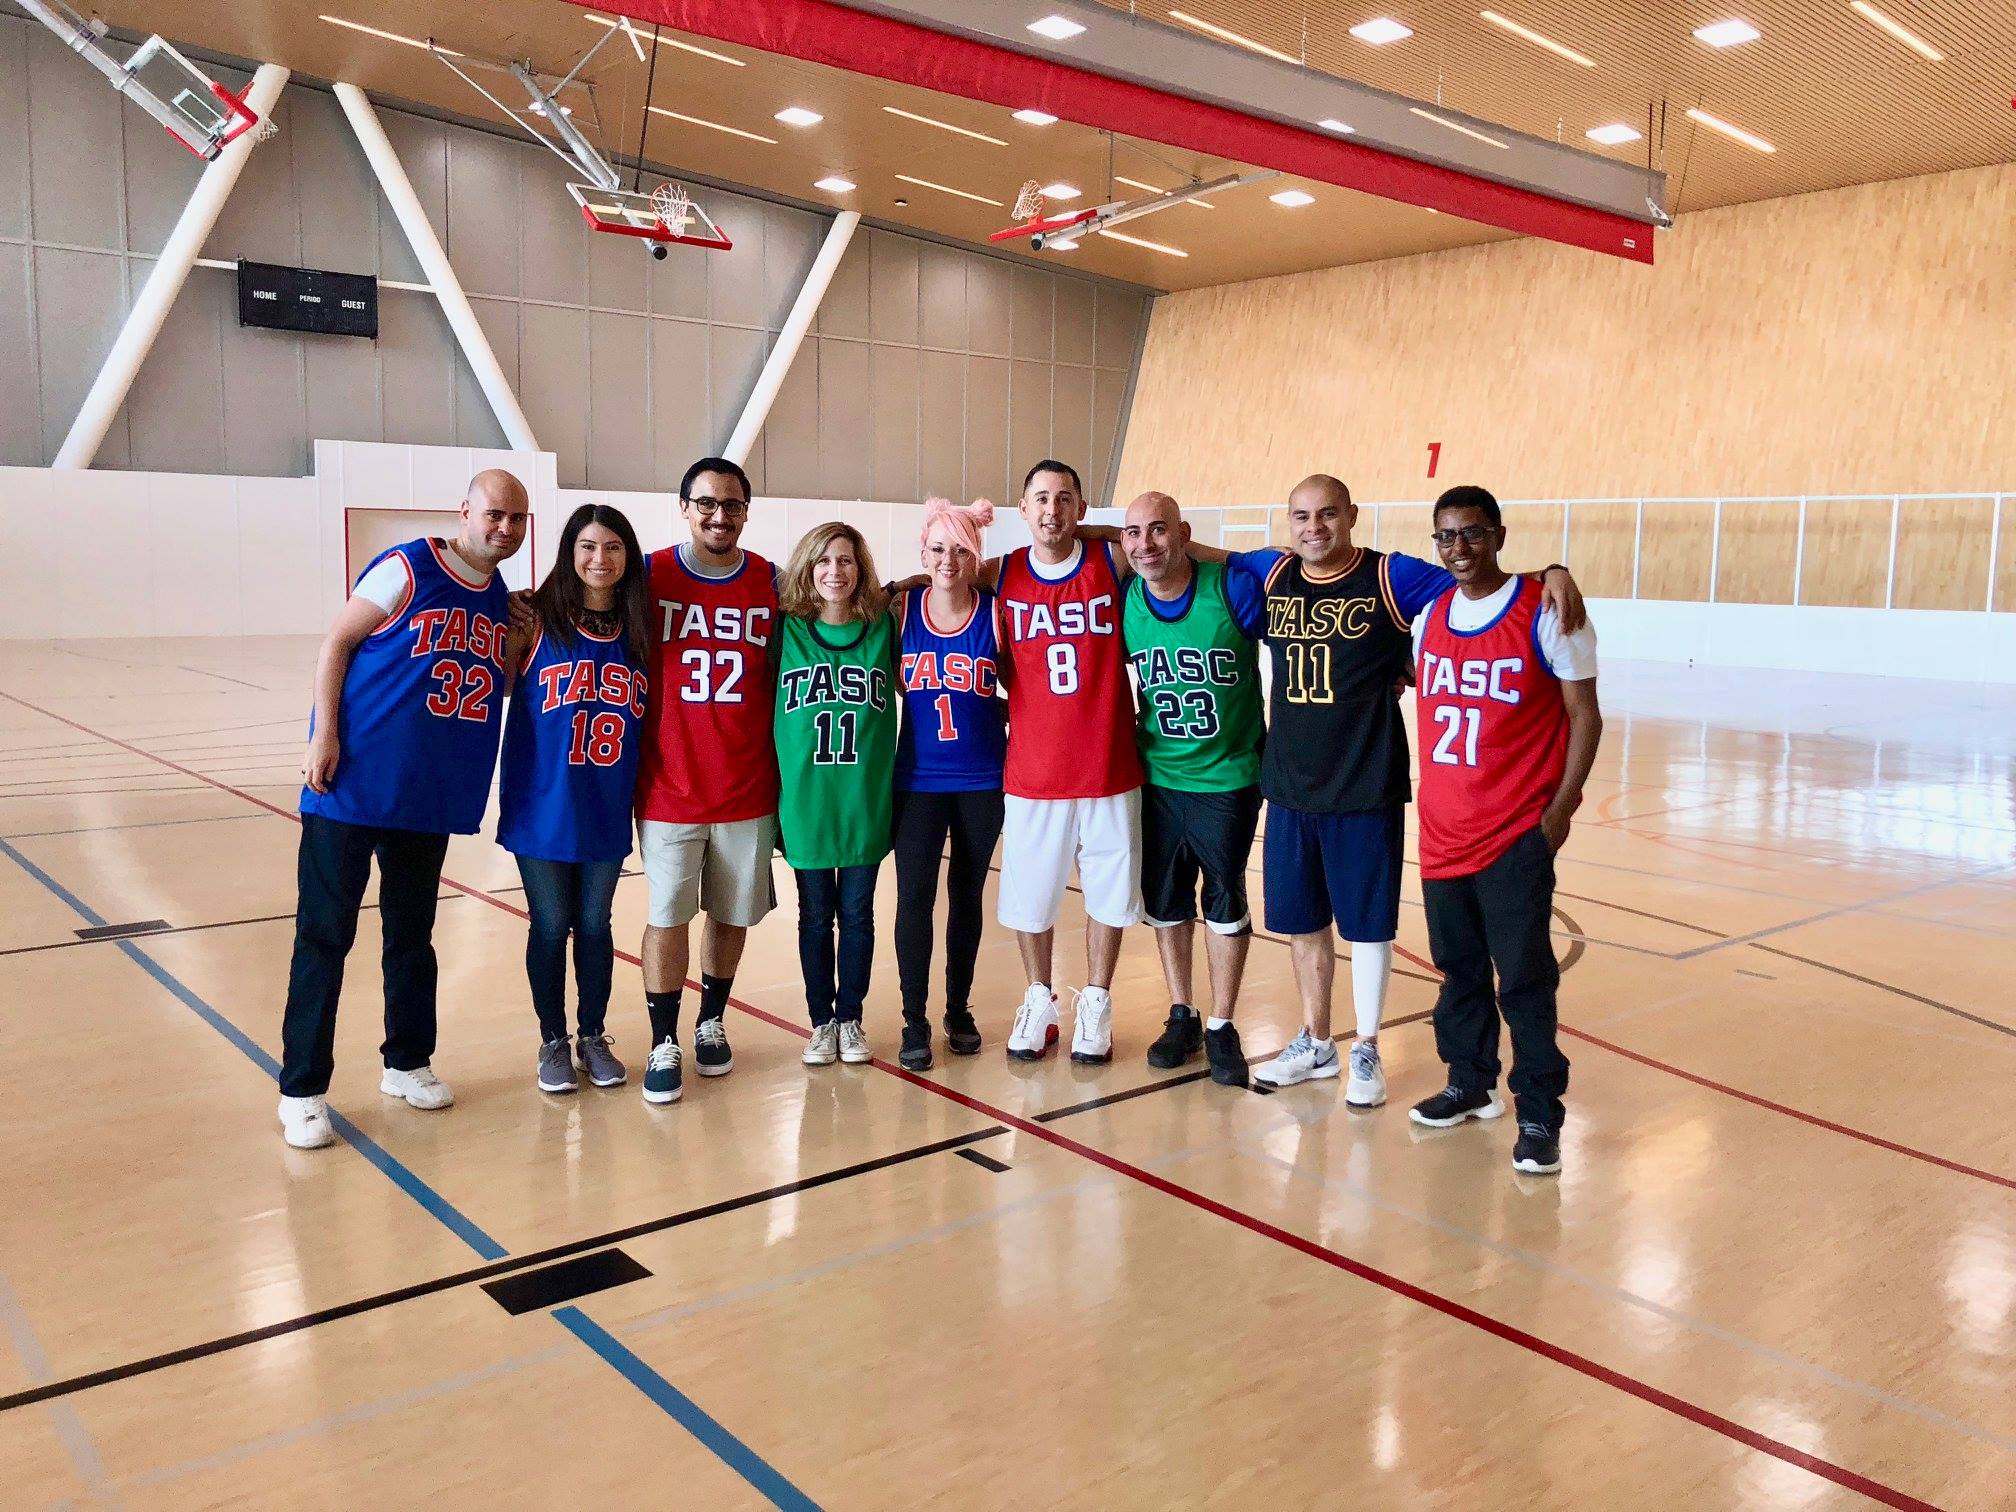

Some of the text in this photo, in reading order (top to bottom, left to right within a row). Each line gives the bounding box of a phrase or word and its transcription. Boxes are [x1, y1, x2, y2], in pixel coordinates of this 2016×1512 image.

[253, 290, 277, 300] HOME
[299, 295, 321, 303] PERIOD
[341, 300, 366, 310] GUEST
[1427, 442, 1441, 478] 1
[409, 607, 508, 674] TASC
[658, 599, 770, 647] TASC
[1006, 594, 1114, 642] TASC
[1267, 596, 1376, 639] TASC
[426, 658, 494, 722] 32
[539, 660, 648, 719] TASC
[681, 649, 743, 703] 32
[782, 663, 887, 714] TASC
[900, 652, 998, 697] TASC
[1046, 643, 1078, 696] 8
[1130, 646, 1239, 692] TASC
[1286, 643, 1334, 704] 11
[1422, 650, 1523, 704] TASC
[569, 710, 625, 766] 18
[814, 711, 858, 765] 11
[934, 694, 958, 742] 1
[1153, 688, 1220, 738] 23
[1432, 704, 1481, 767] 21
